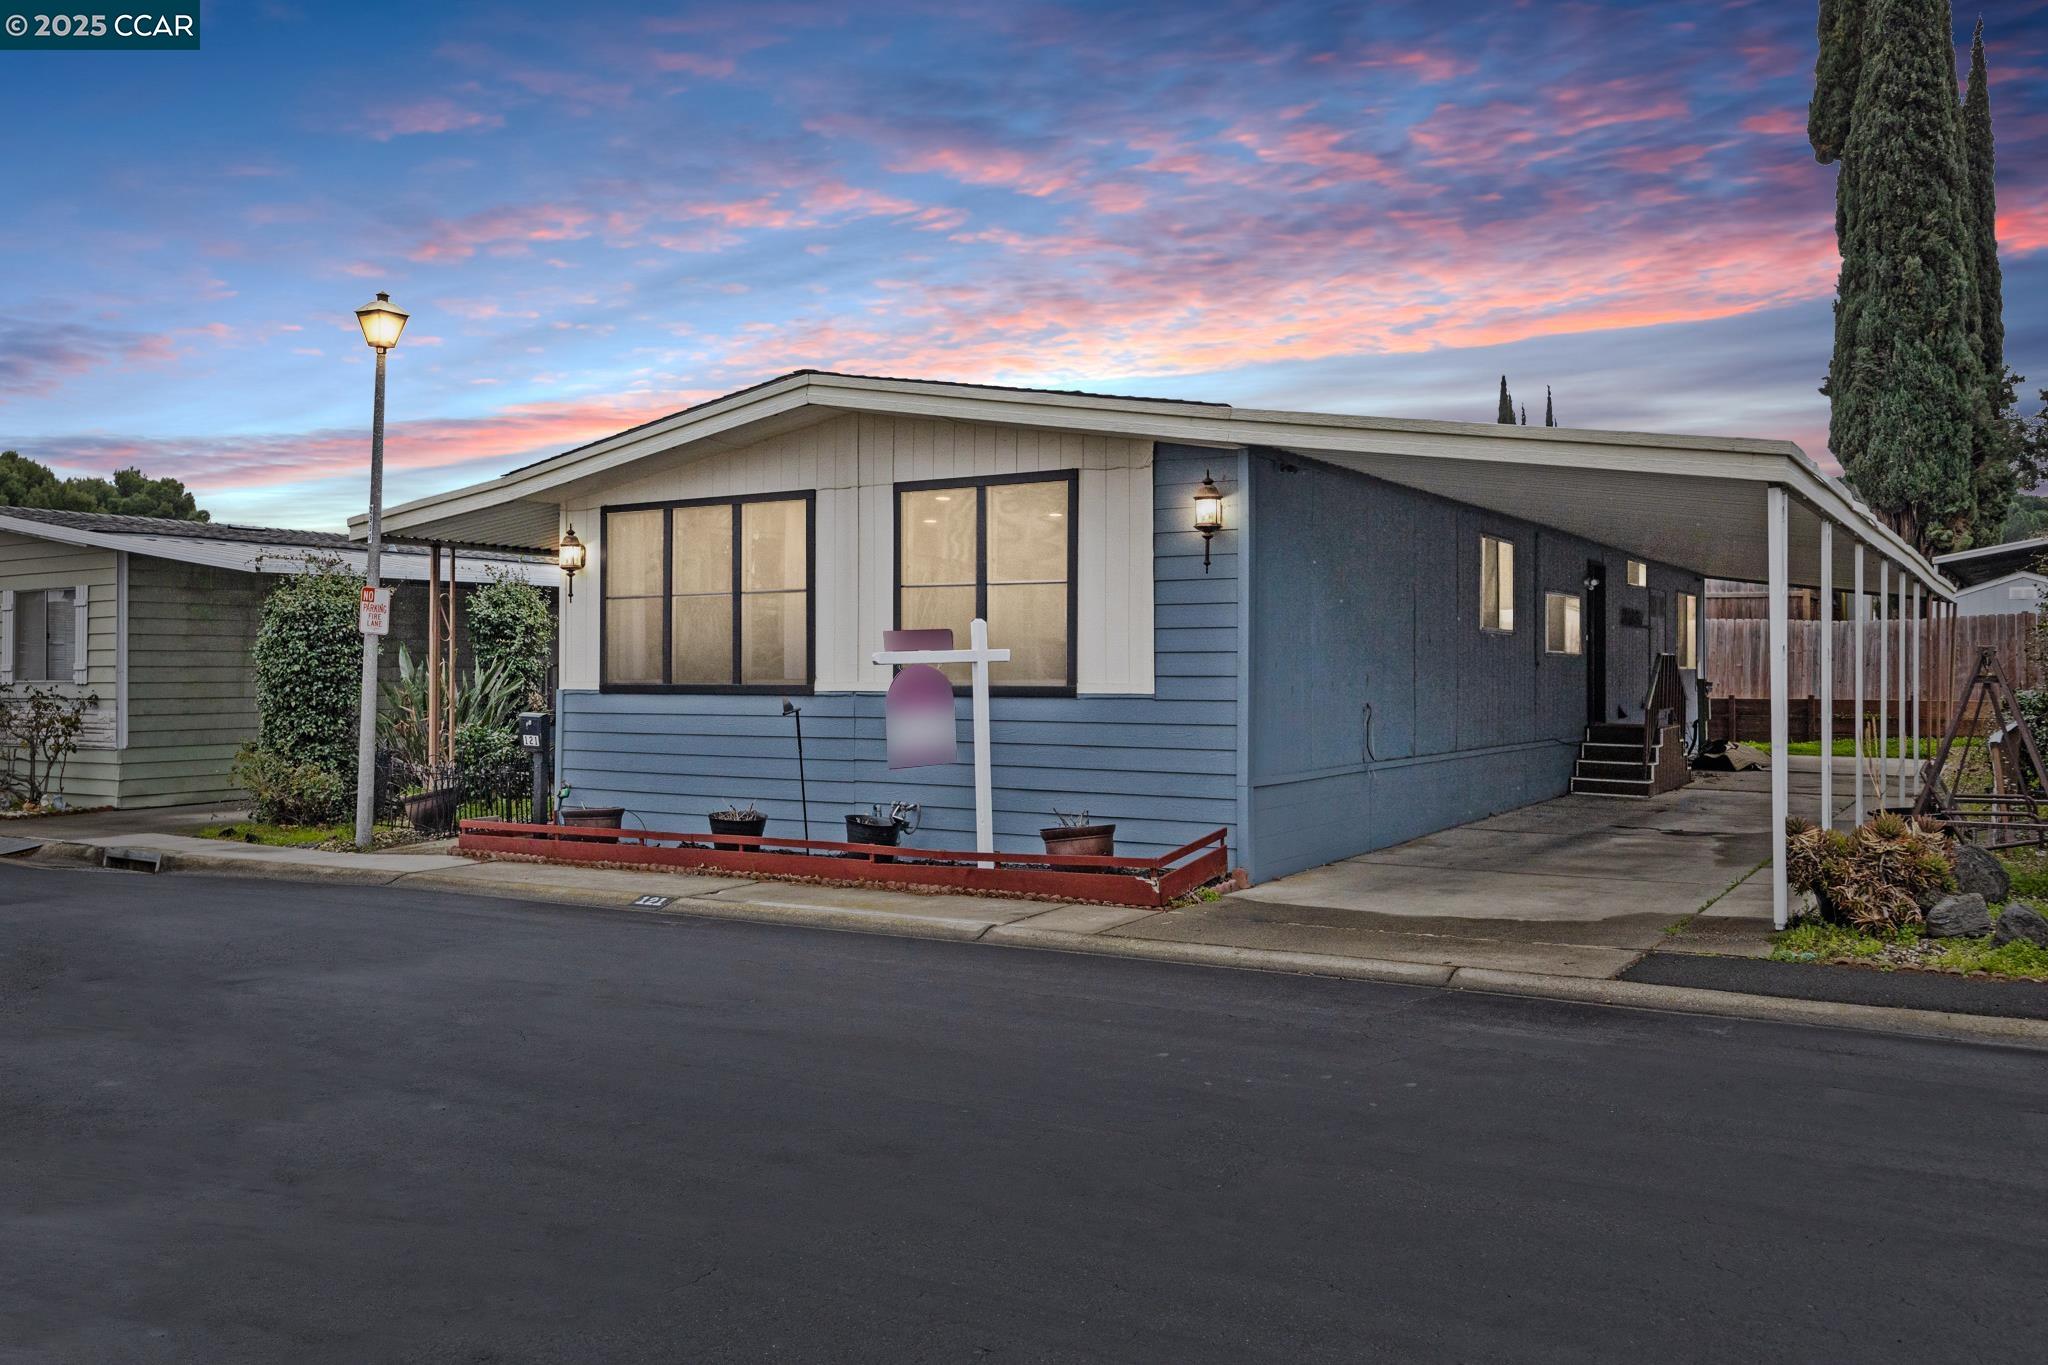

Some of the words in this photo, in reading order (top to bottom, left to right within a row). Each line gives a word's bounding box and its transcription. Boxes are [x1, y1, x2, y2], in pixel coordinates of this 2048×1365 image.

[363, 590, 374, 601] NO
[363, 603, 387, 614] PARKING
[368, 613, 382, 621] FIRE
[367, 620, 383, 628] LANE
[524, 735, 538, 746] 121
[635, 896, 668, 906] 121
